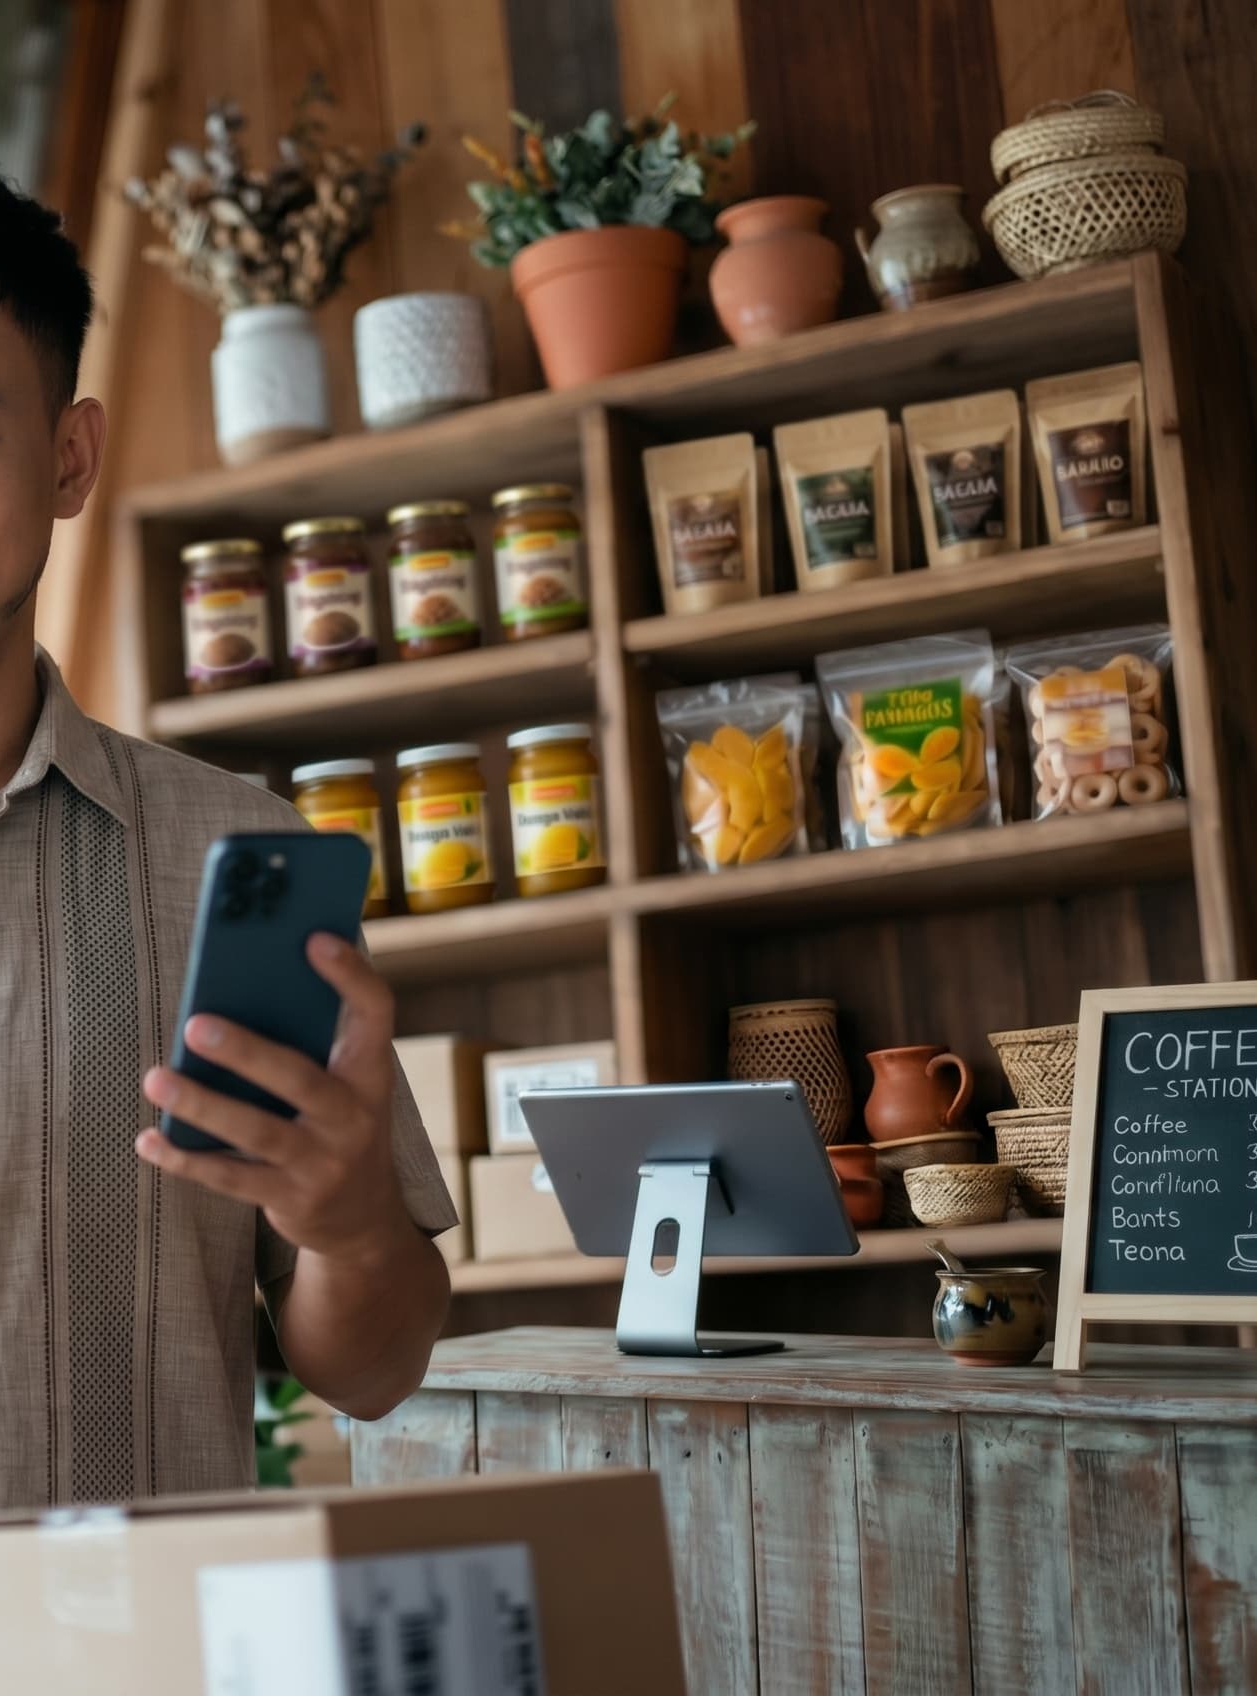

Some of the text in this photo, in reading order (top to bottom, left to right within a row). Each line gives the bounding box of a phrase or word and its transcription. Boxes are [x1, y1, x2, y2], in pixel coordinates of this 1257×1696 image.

[1114, 1113, 1189, 1135] Coffee
[1111, 1206, 1181, 1229] Bants
[1107, 1239, 1186, 1262] Teona
